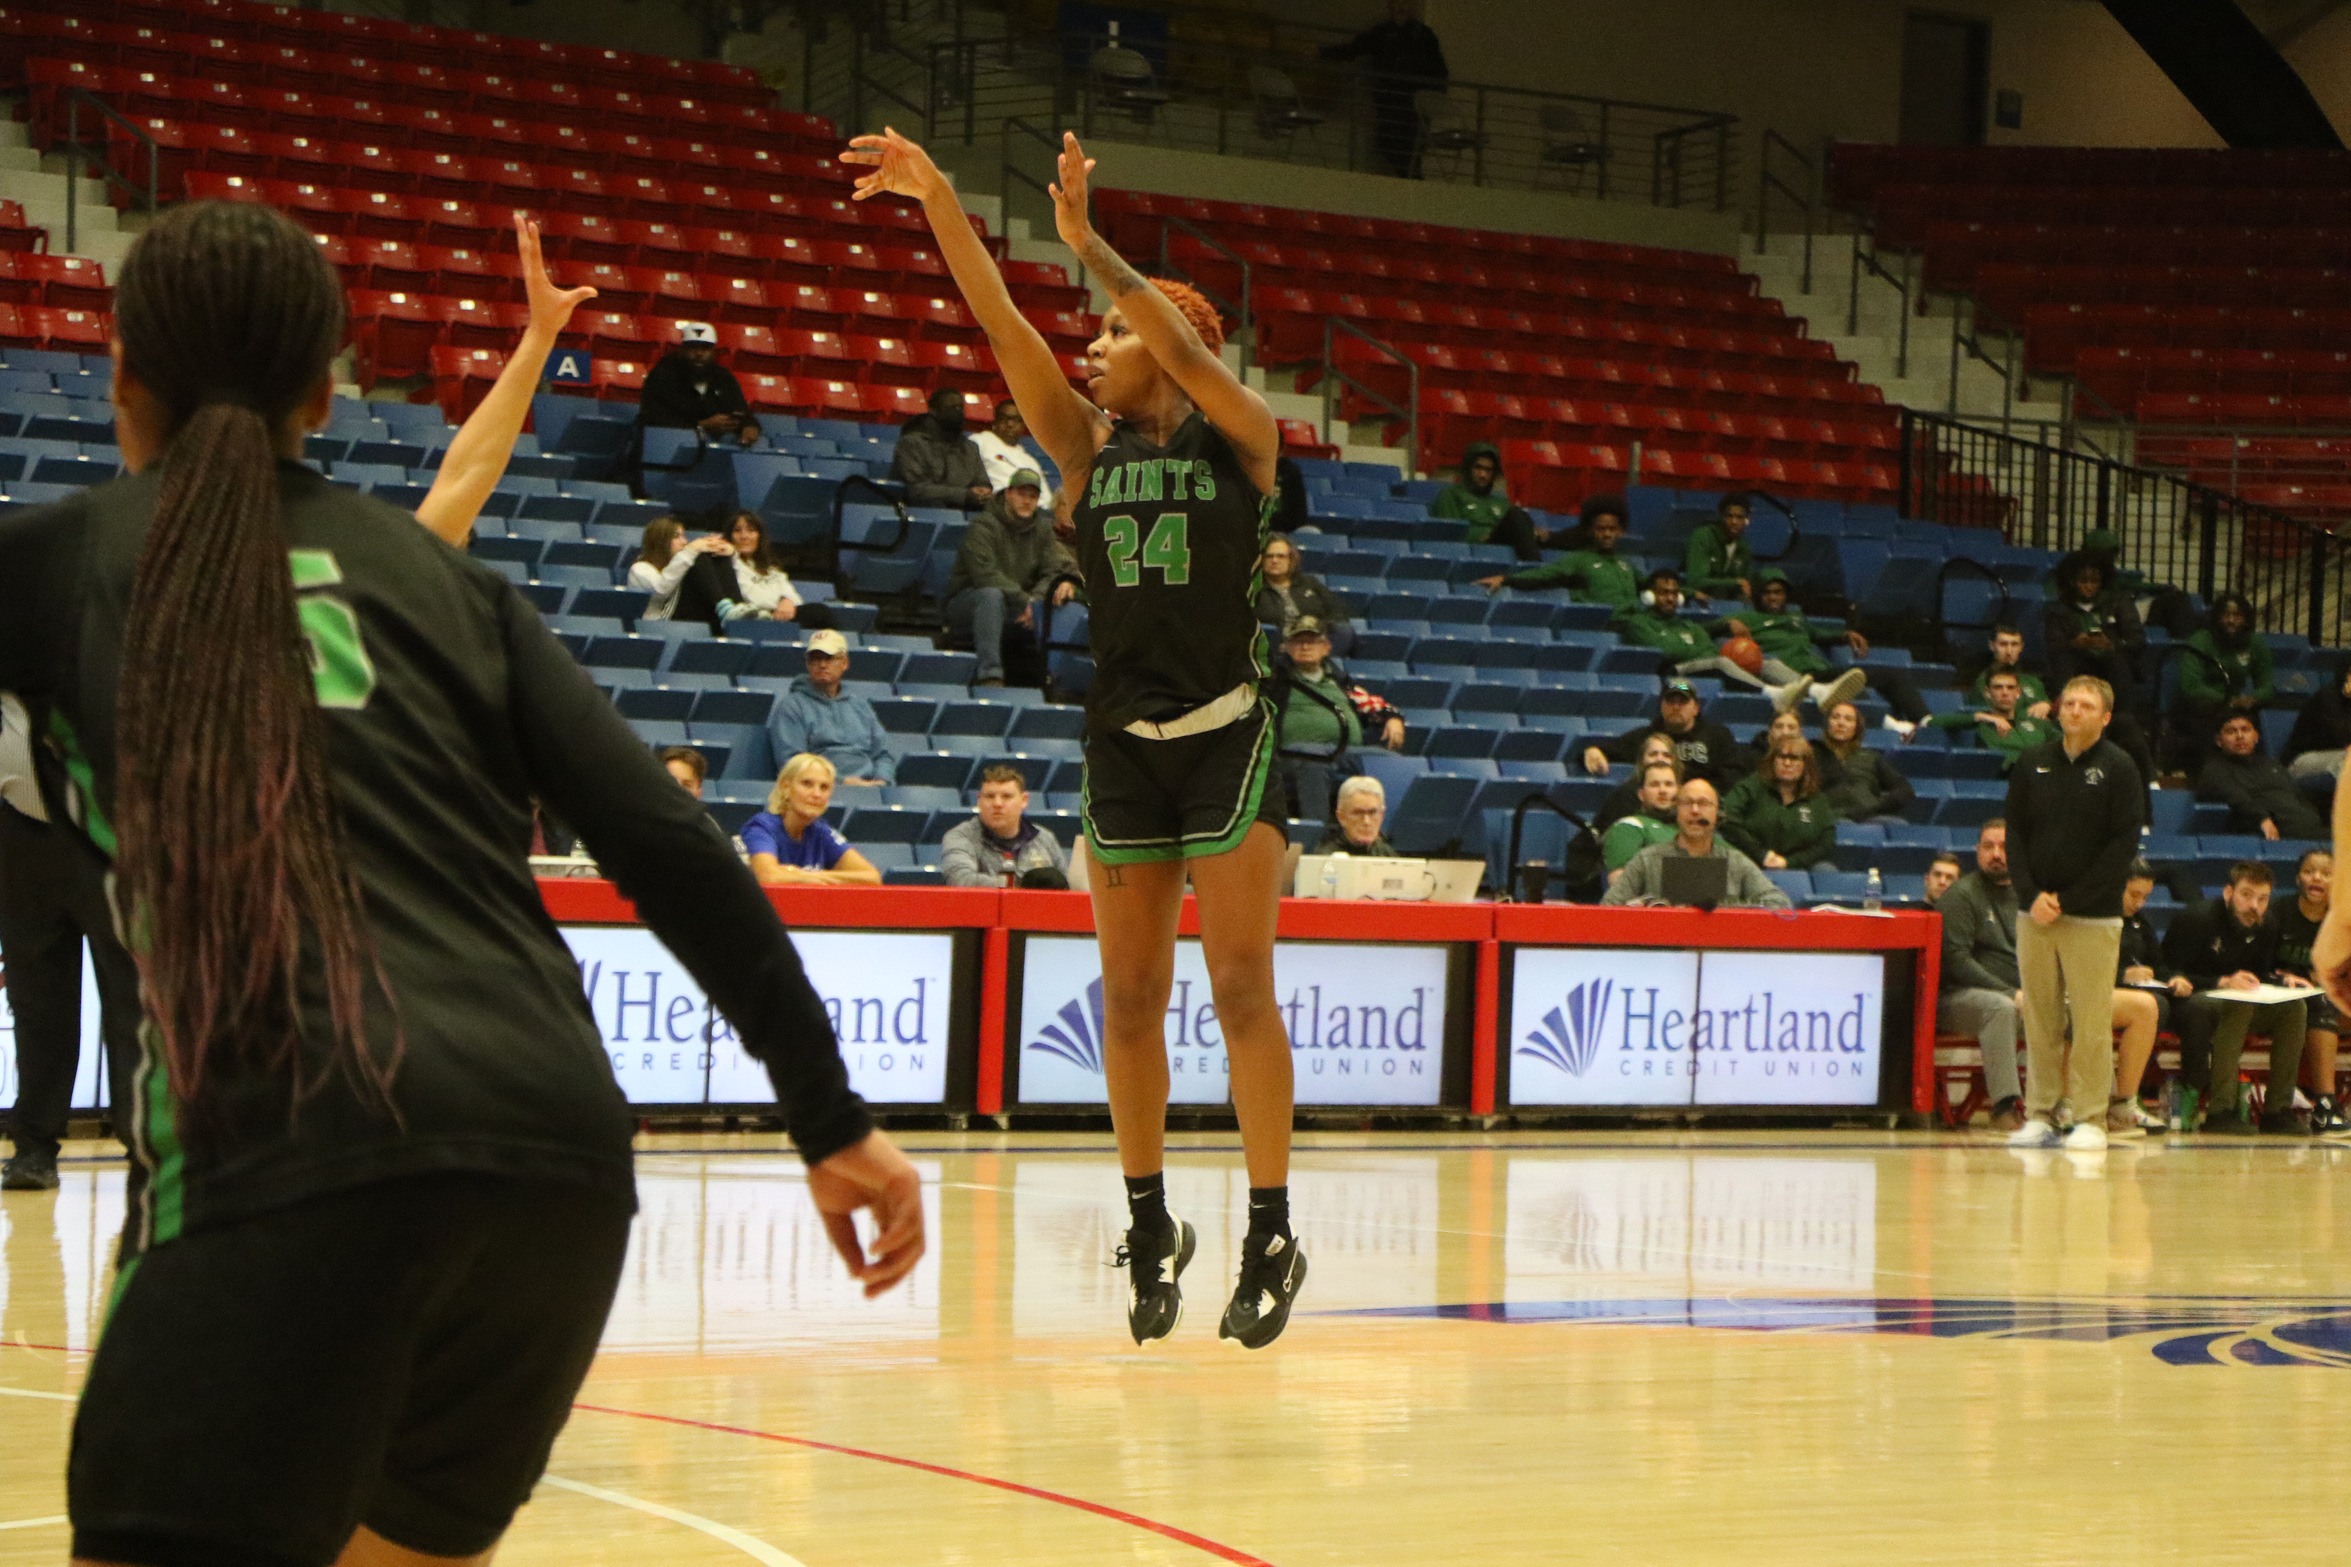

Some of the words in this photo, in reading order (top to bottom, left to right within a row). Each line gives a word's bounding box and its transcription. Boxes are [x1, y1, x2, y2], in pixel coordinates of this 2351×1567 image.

[556, 355, 581, 378] A
[1089, 458, 1217, 509] SAINTS
[1103, 512, 1191, 587] 24
[1168, 980, 1427, 1052] Hetland
[1619, 987, 1866, 1054] Heartland
[612, 1052, 762, 1072] CREDI
[1312, 1057, 1424, 1076] UNION
[1619, 1059, 1740, 1077] CREDIT
[1764, 1059, 1863, 1077] UNION
